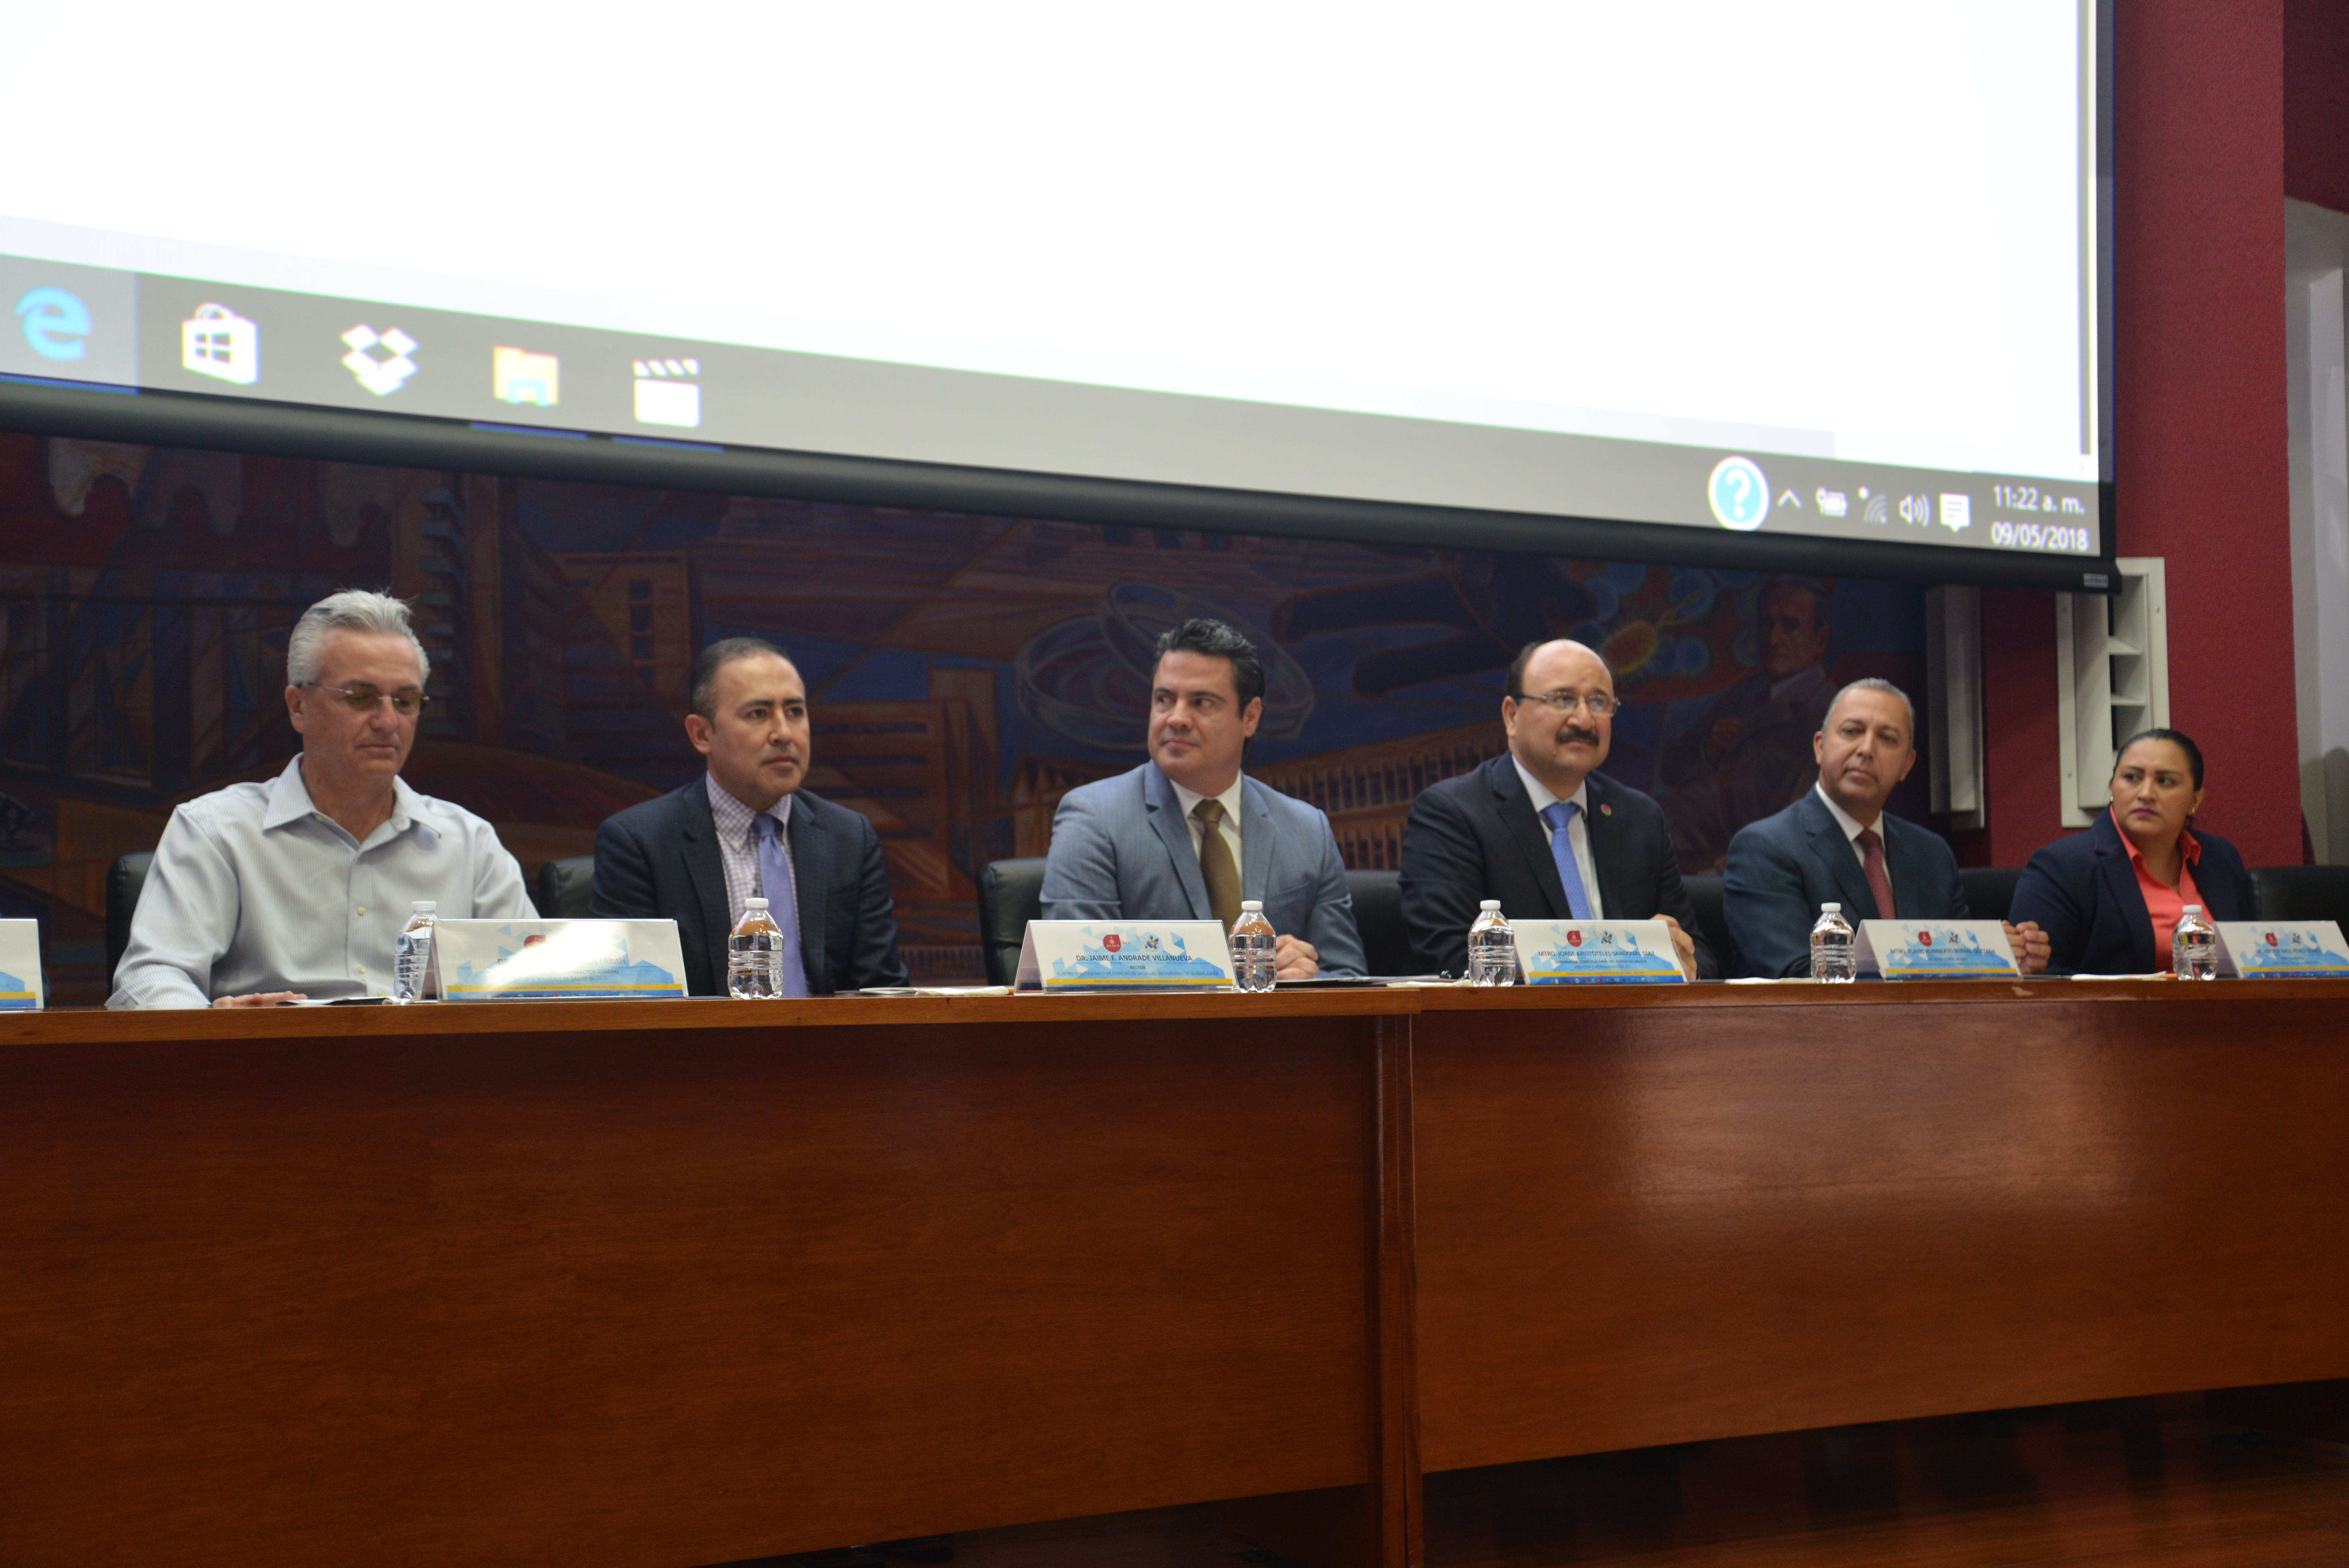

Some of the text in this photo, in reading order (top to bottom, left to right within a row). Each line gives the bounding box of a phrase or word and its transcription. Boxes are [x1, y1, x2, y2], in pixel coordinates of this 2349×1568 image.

[1994, 485, 2086, 514] 11:22 a. m.
[1991, 521, 2090, 552] 09/05/2018
